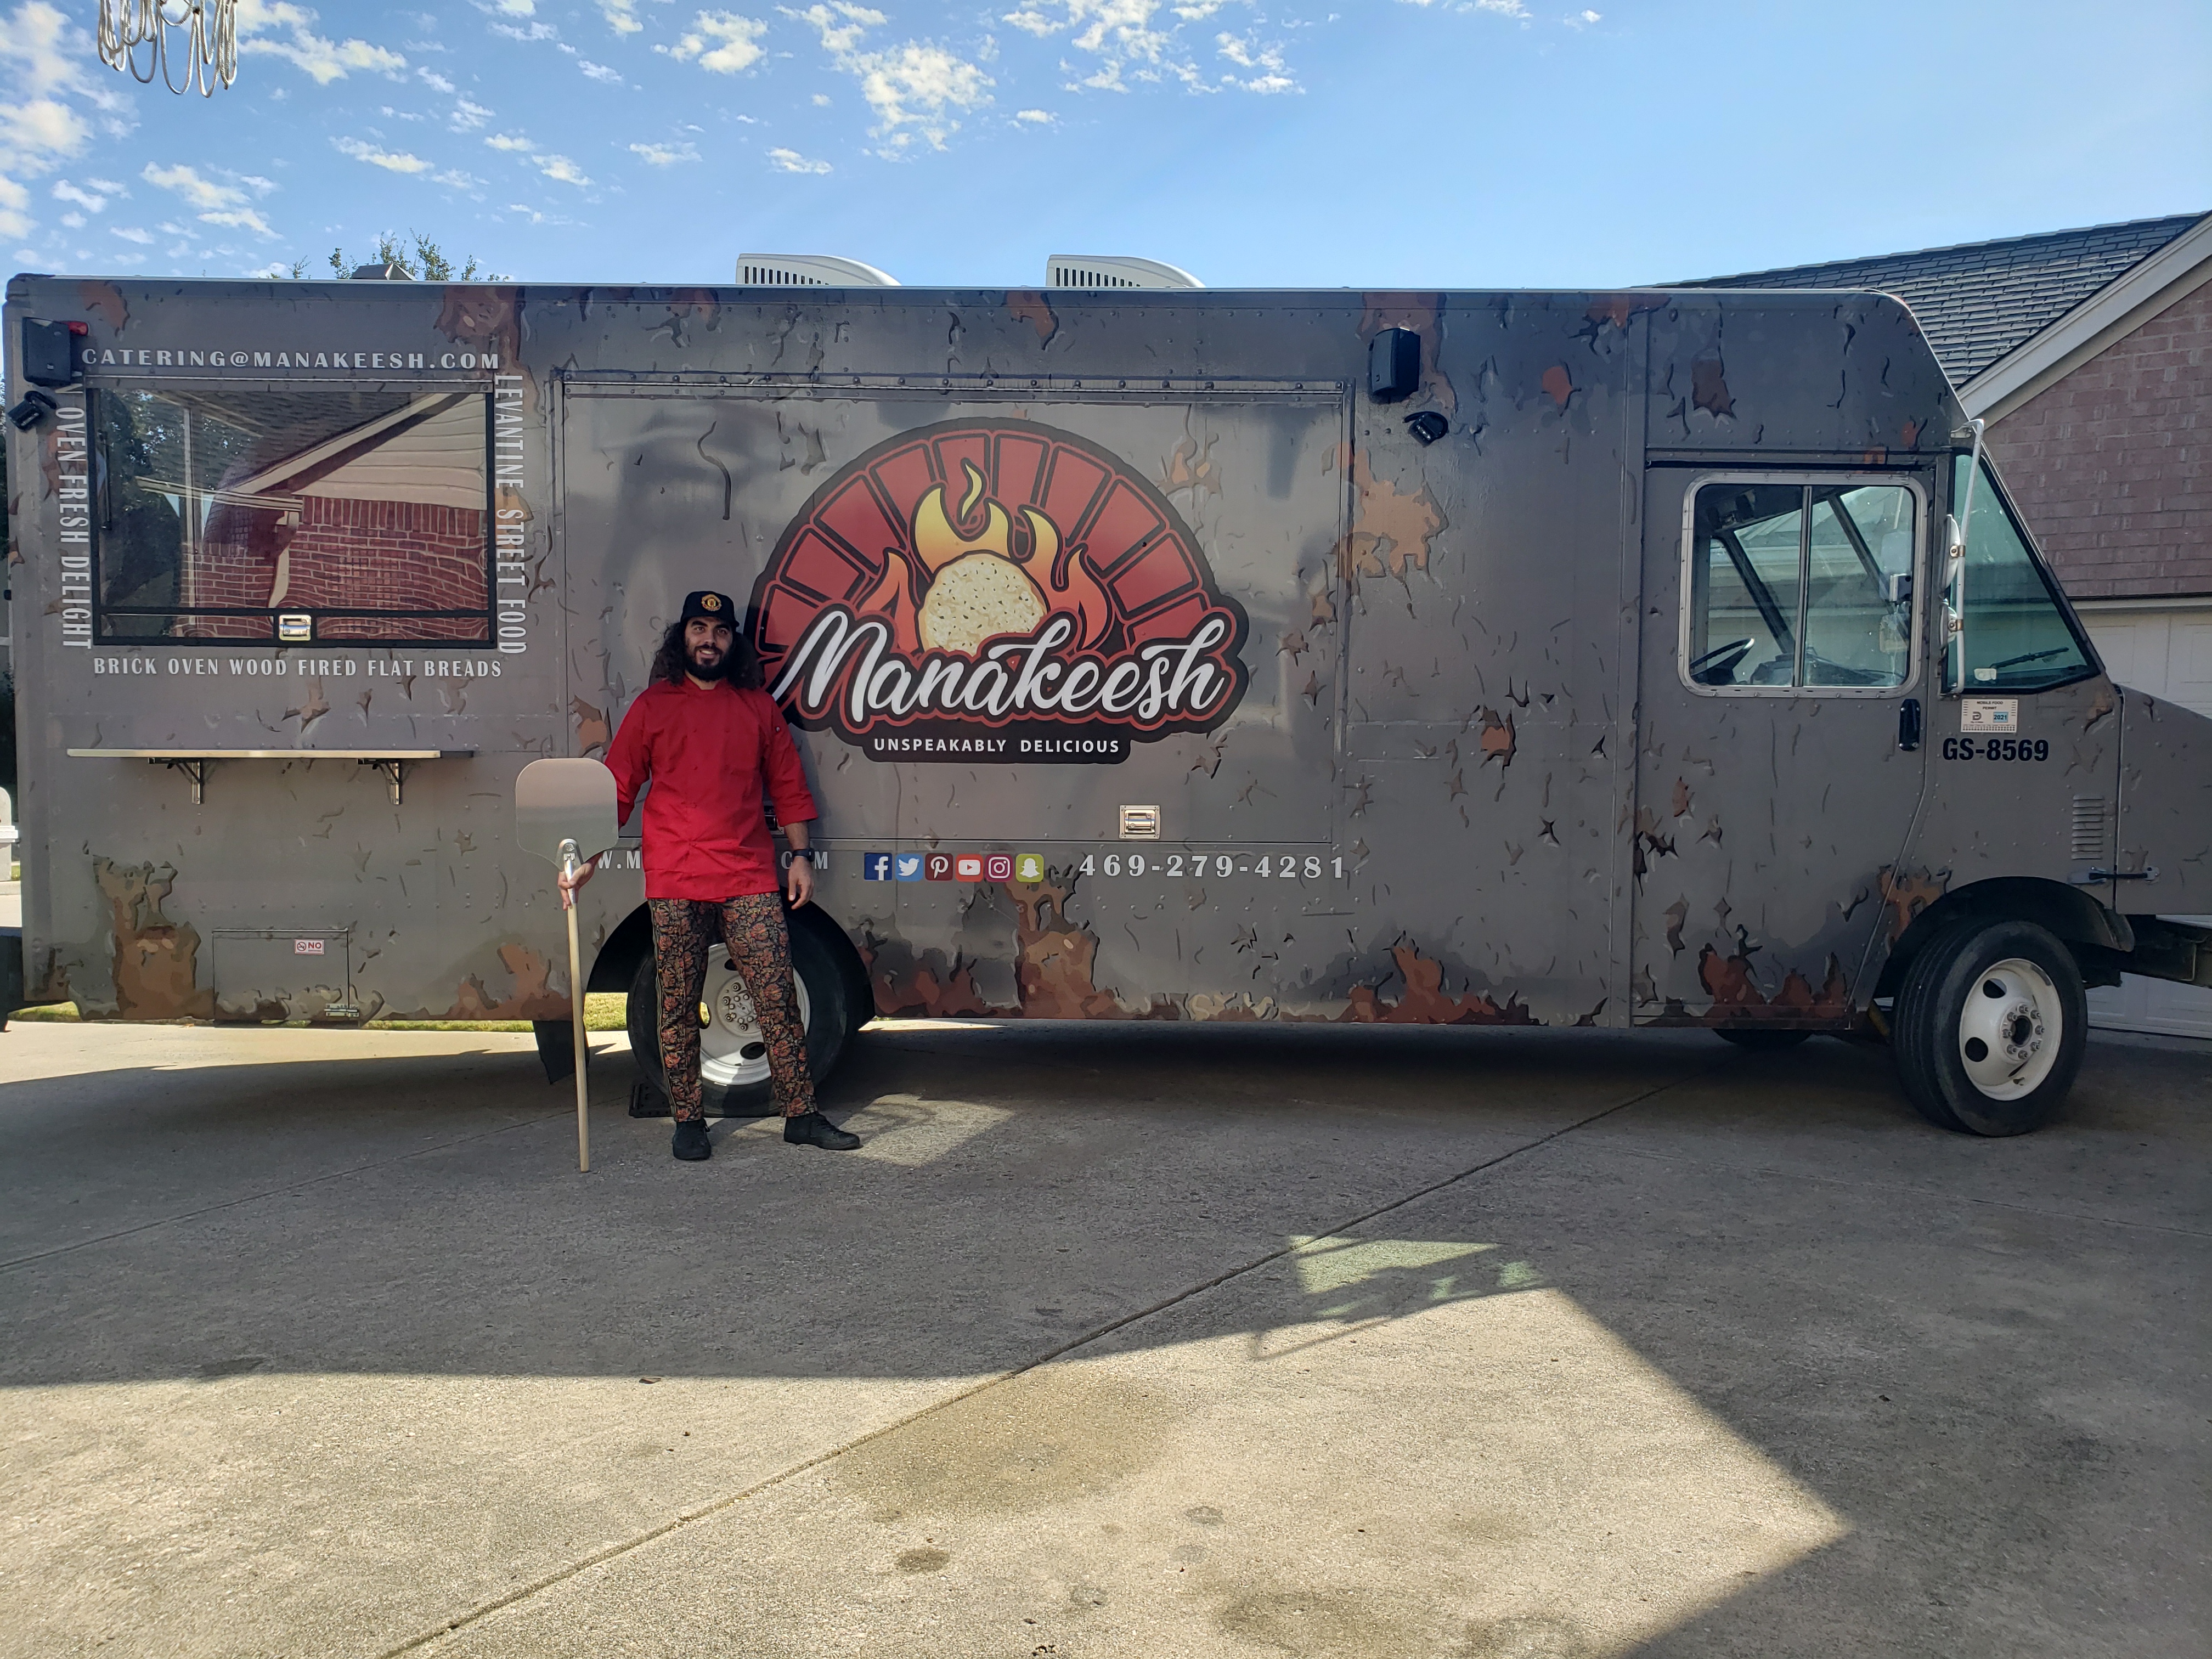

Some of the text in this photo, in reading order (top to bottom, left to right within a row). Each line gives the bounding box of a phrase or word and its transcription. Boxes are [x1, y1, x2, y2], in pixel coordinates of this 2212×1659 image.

[81, 348, 500, 370] CATERING@MANAKEESH.COM
[55, 407, 86, 462] OVEN
[58, 474, 89, 543] FRESH
[494, 375, 527, 654] LEVANTINE STREET FOOD
[61, 556, 92, 650] DELIGHT
[94, 658, 502, 677] BRICK OVEN WOOD FIRED FLAT BREADS
[874, 738, 1119, 753] UNSPEAKABLY DELICIOUS
[1943, 737, 2049, 761] GS-8569
[1079, 854, 1342, 878] 469-279-4281
